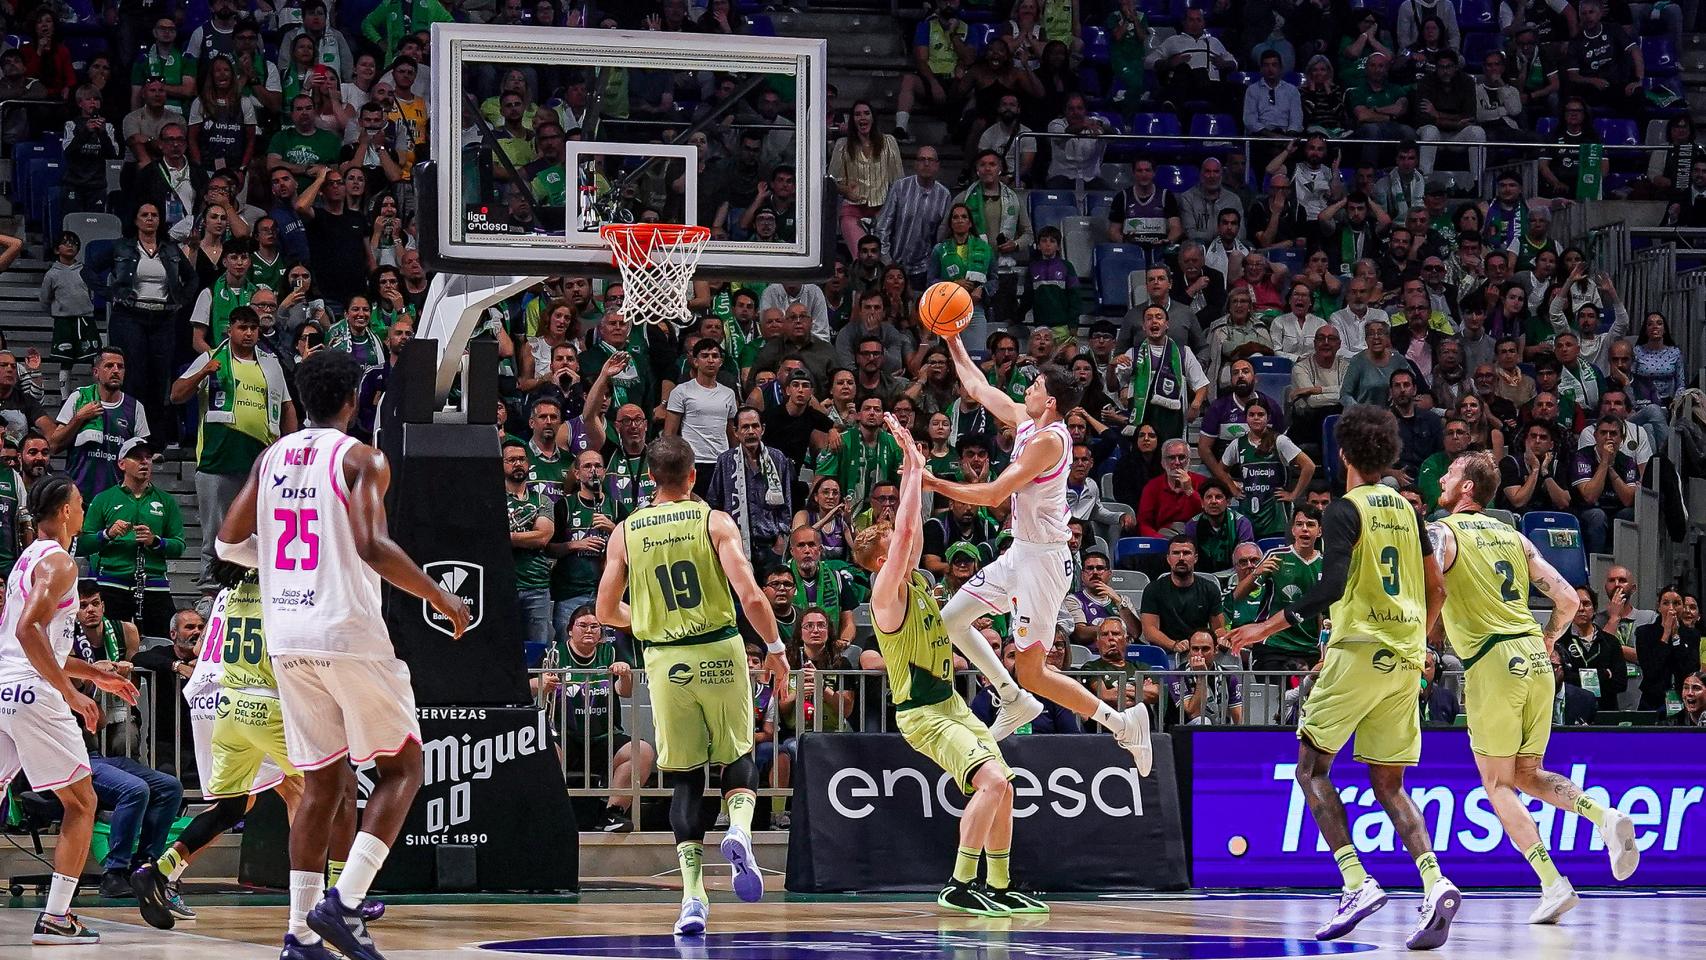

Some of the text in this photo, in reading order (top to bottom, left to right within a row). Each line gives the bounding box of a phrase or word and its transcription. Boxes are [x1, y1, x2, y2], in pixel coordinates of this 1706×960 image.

[467, 209, 487, 223] liga
[467, 222, 508, 232] endesa
[274, 507, 320, 571] 25
[1380, 545, 1401, 597] 3
[654, 560, 703, 612] 19
[1494, 560, 1522, 603] 2
[223, 616, 263, 665] 55
[699, 659, 735, 669] COSTA
[699, 669, 735, 678] DEL SOL
[236, 699, 268, 711] COSTA
[234, 708, 268, 719] DEL SOL
[414, 709, 487, 720] CERVEZAS
[424, 710, 547, 786] Miguel
[427, 781, 471, 833] 0,0
[405, 833, 488, 845] SINCE 1890
